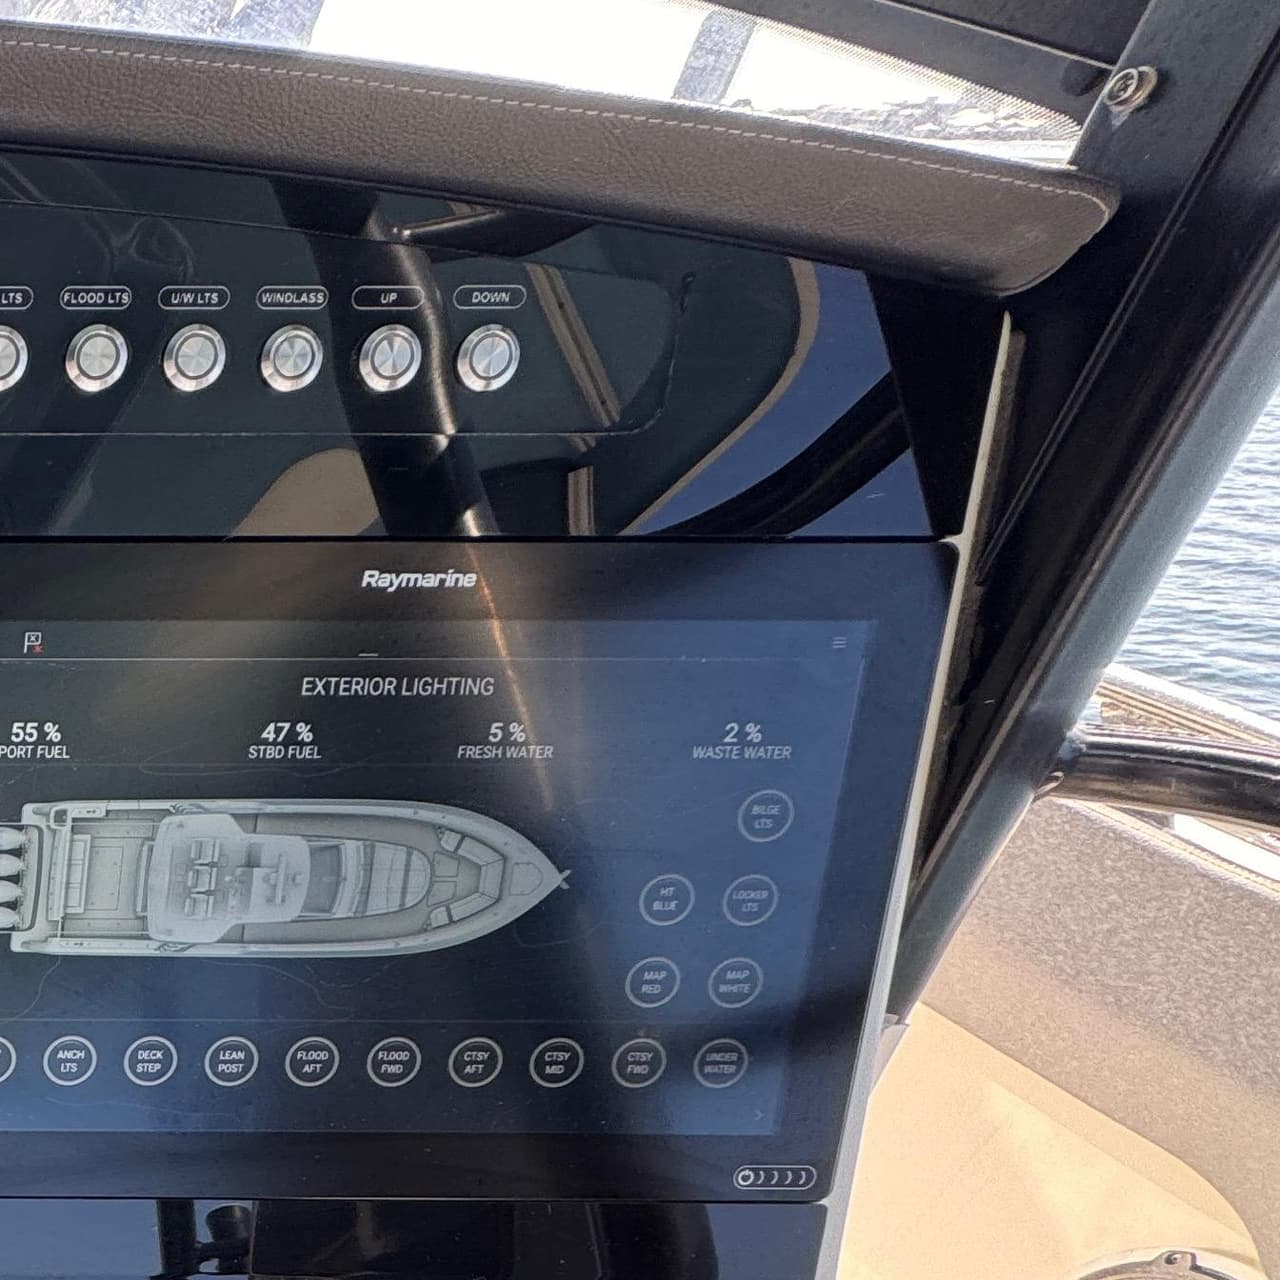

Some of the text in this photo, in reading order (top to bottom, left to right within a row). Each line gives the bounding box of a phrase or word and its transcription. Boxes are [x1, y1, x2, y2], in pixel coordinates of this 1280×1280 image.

[1, 292, 23, 304] LTS
[63, 292, 130, 304] FLOOD LTS
[171, 292, 219, 304] U/W LTS
[261, 292, 324, 304] WINDLASS
[380, 292, 398, 304] UP
[471, 292, 510, 303] DOWN
[361, 569, 478, 592] Raymarine
[301, 677, 494, 697] EXTERIOR LIGHTING
[11, 722, 62, 743] 55 %
[261, 722, 314, 743] 47 %
[488, 722, 526, 742] 5 %
[723, 723, 763, 743] 2 %
[39, 745, 70, 759] FUEL
[248, 745, 322, 760] STBD FUEL
[457, 745, 554, 760] FRESH WATER
[692, 745, 792, 760] WASTE WATER
[57, 1050, 85, 1060] ANCH
[137, 1050, 164, 1060] DECK
[219, 1050, 245, 1060] LEAN
[297, 1050, 328, 1061] FLOOD
[378, 1051, 410, 1061] FLOOD
[464, 1051, 490, 1061] CTSY
[545, 1051, 571, 1061] CTSY
[627, 1051, 654, 1062] CTSY
[60, 1063, 78, 1073] LTS
[136, 1063, 161, 1073] STEP
[218, 1063, 243, 1073] POST
[302, 1063, 322, 1073] AFT
[381, 1064, 403, 1074] FWD
[463, 1064, 484, 1074] AFT
[545, 1064, 564, 1075] MID
[627, 1064, 649, 1075] FWD
